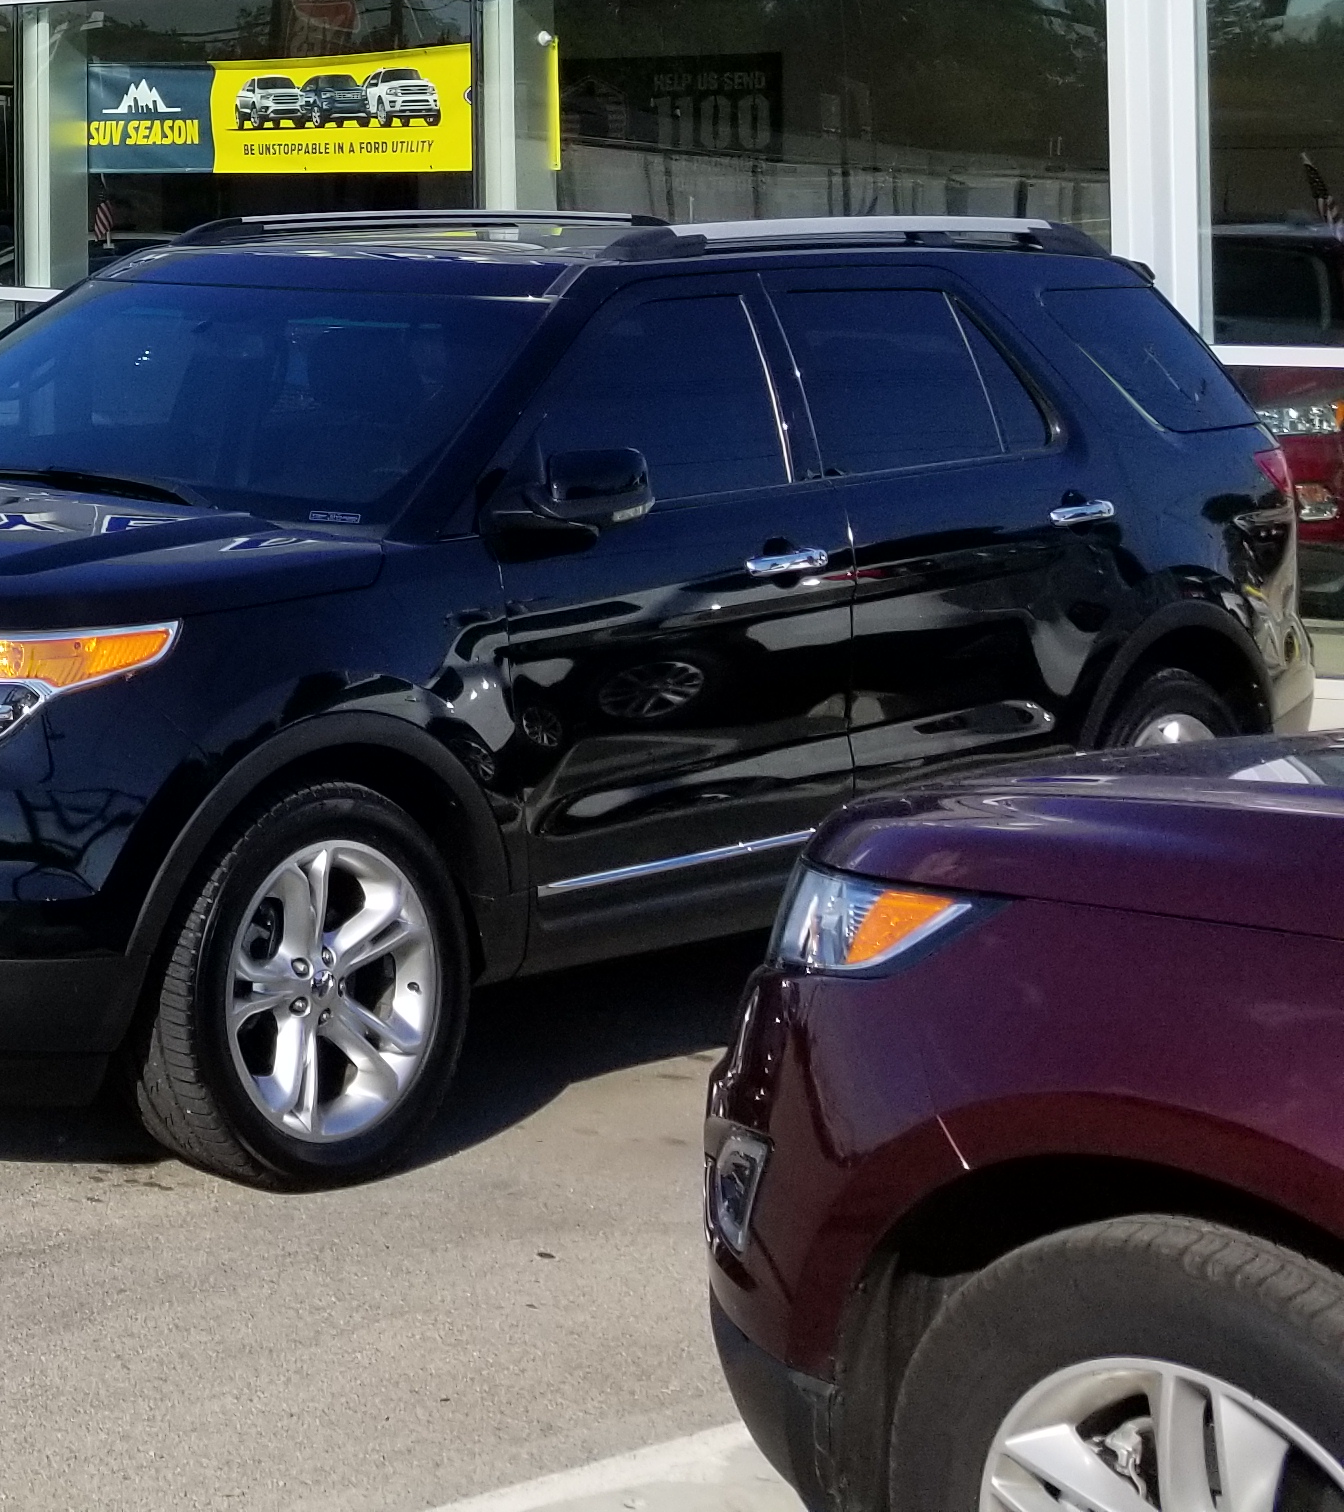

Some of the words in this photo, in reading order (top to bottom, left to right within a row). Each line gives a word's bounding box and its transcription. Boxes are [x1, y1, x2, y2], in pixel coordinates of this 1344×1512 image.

[653, 72, 693, 92] HELP
[697, 71, 720, 91] US
[723, 71, 767, 90] SEND
[88, 120, 125, 146] SUV
[125, 119, 200, 145] SEASON
[243, 143, 255, 156] BE
[258, 142, 330, 156] UNSTOPPABLE
[333, 142, 345, 155] IN
[348, 142, 356, 154] A
[359, 140, 388, 154] FORD
[391, 139, 435, 154] UTILITY
